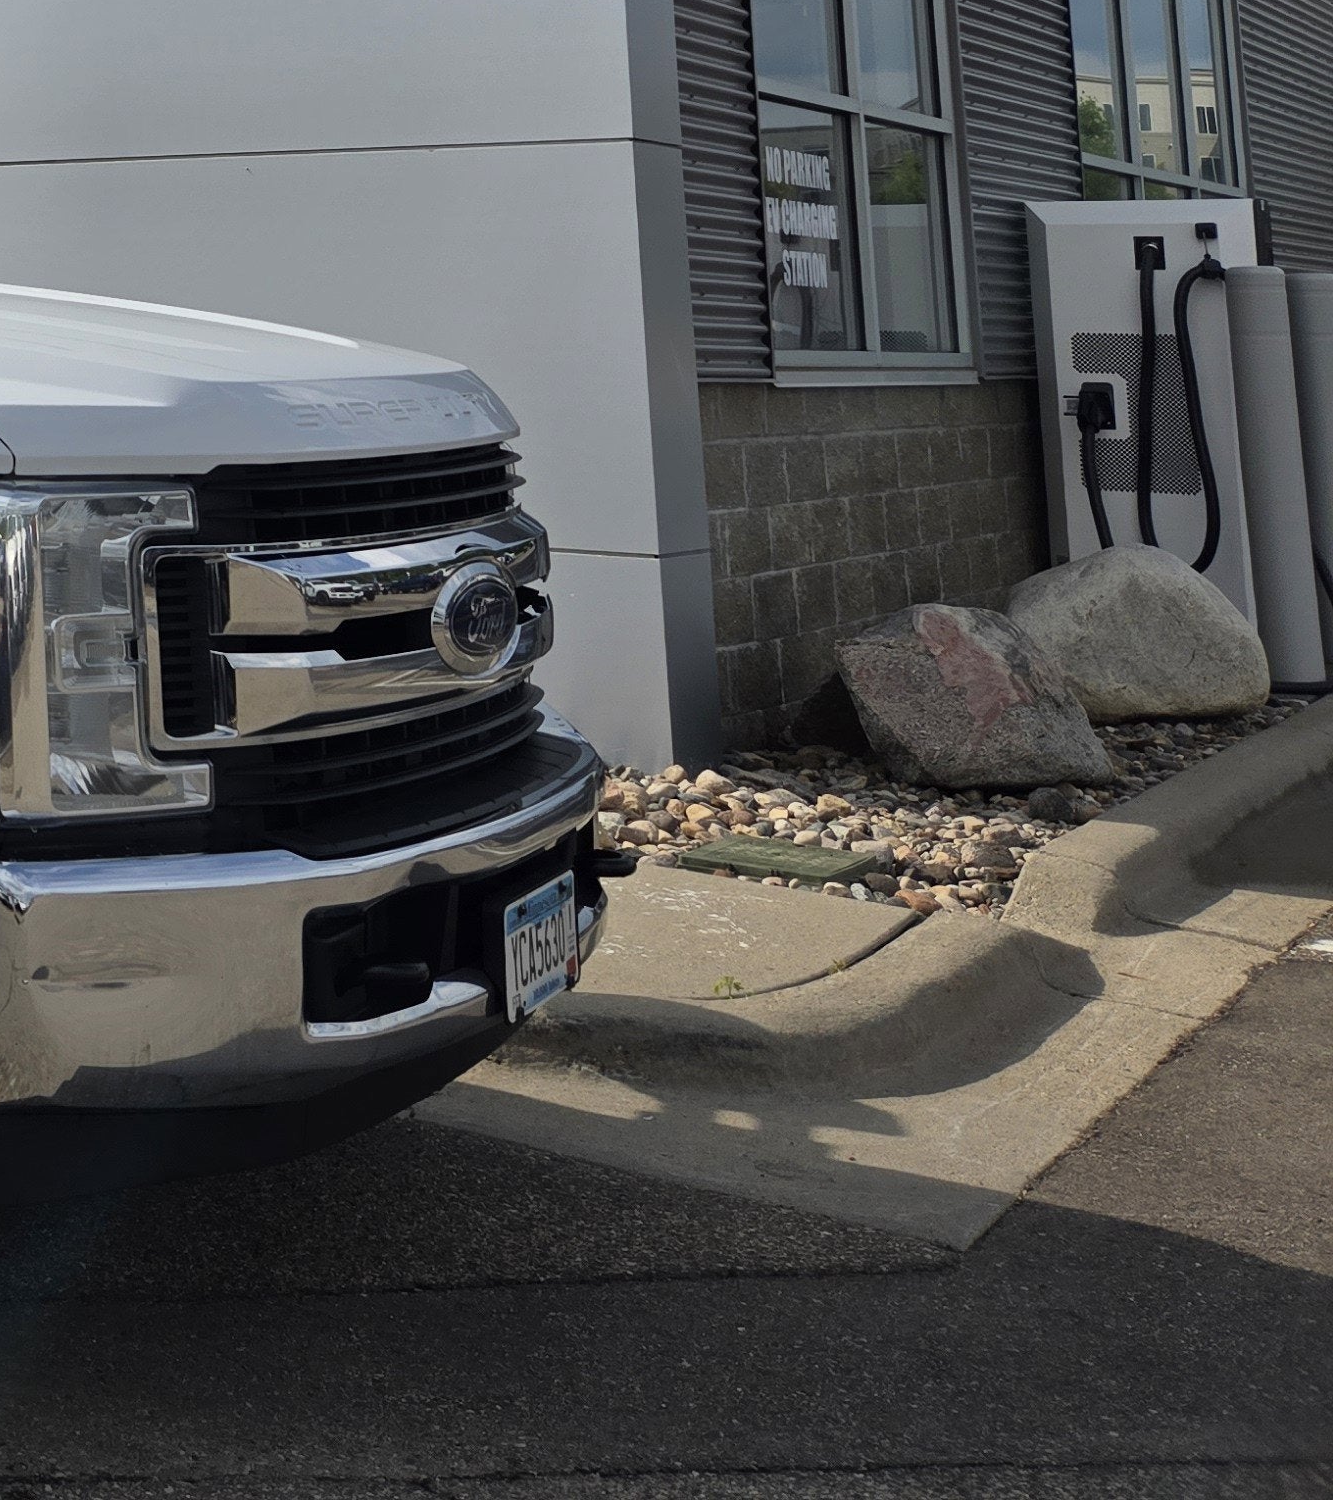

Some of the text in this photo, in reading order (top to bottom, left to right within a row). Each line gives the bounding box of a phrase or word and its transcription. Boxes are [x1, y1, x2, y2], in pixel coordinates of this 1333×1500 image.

[765, 146, 831, 190] NO PARKING
[781, 199, 837, 239] CHARGING
[783, 249, 828, 288] STATION
[511, 909, 566, 991] YCA5630
